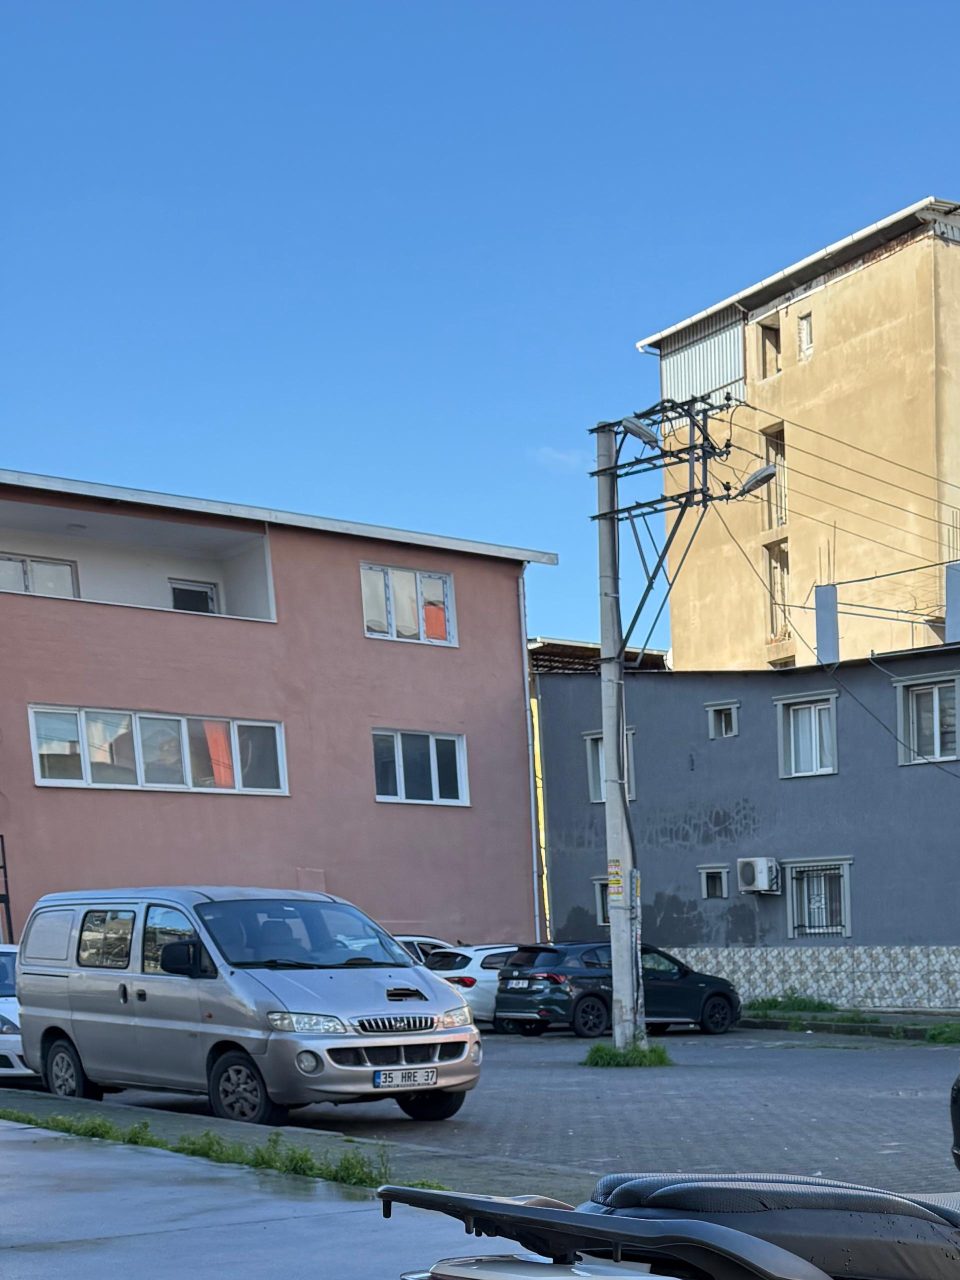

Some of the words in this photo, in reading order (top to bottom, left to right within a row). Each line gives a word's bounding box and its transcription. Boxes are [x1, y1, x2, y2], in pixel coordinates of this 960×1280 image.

[382, 1072, 394, 1084] 35
[401, 1071, 418, 1083] HRE
[424, 1070, 435, 1082] 37
